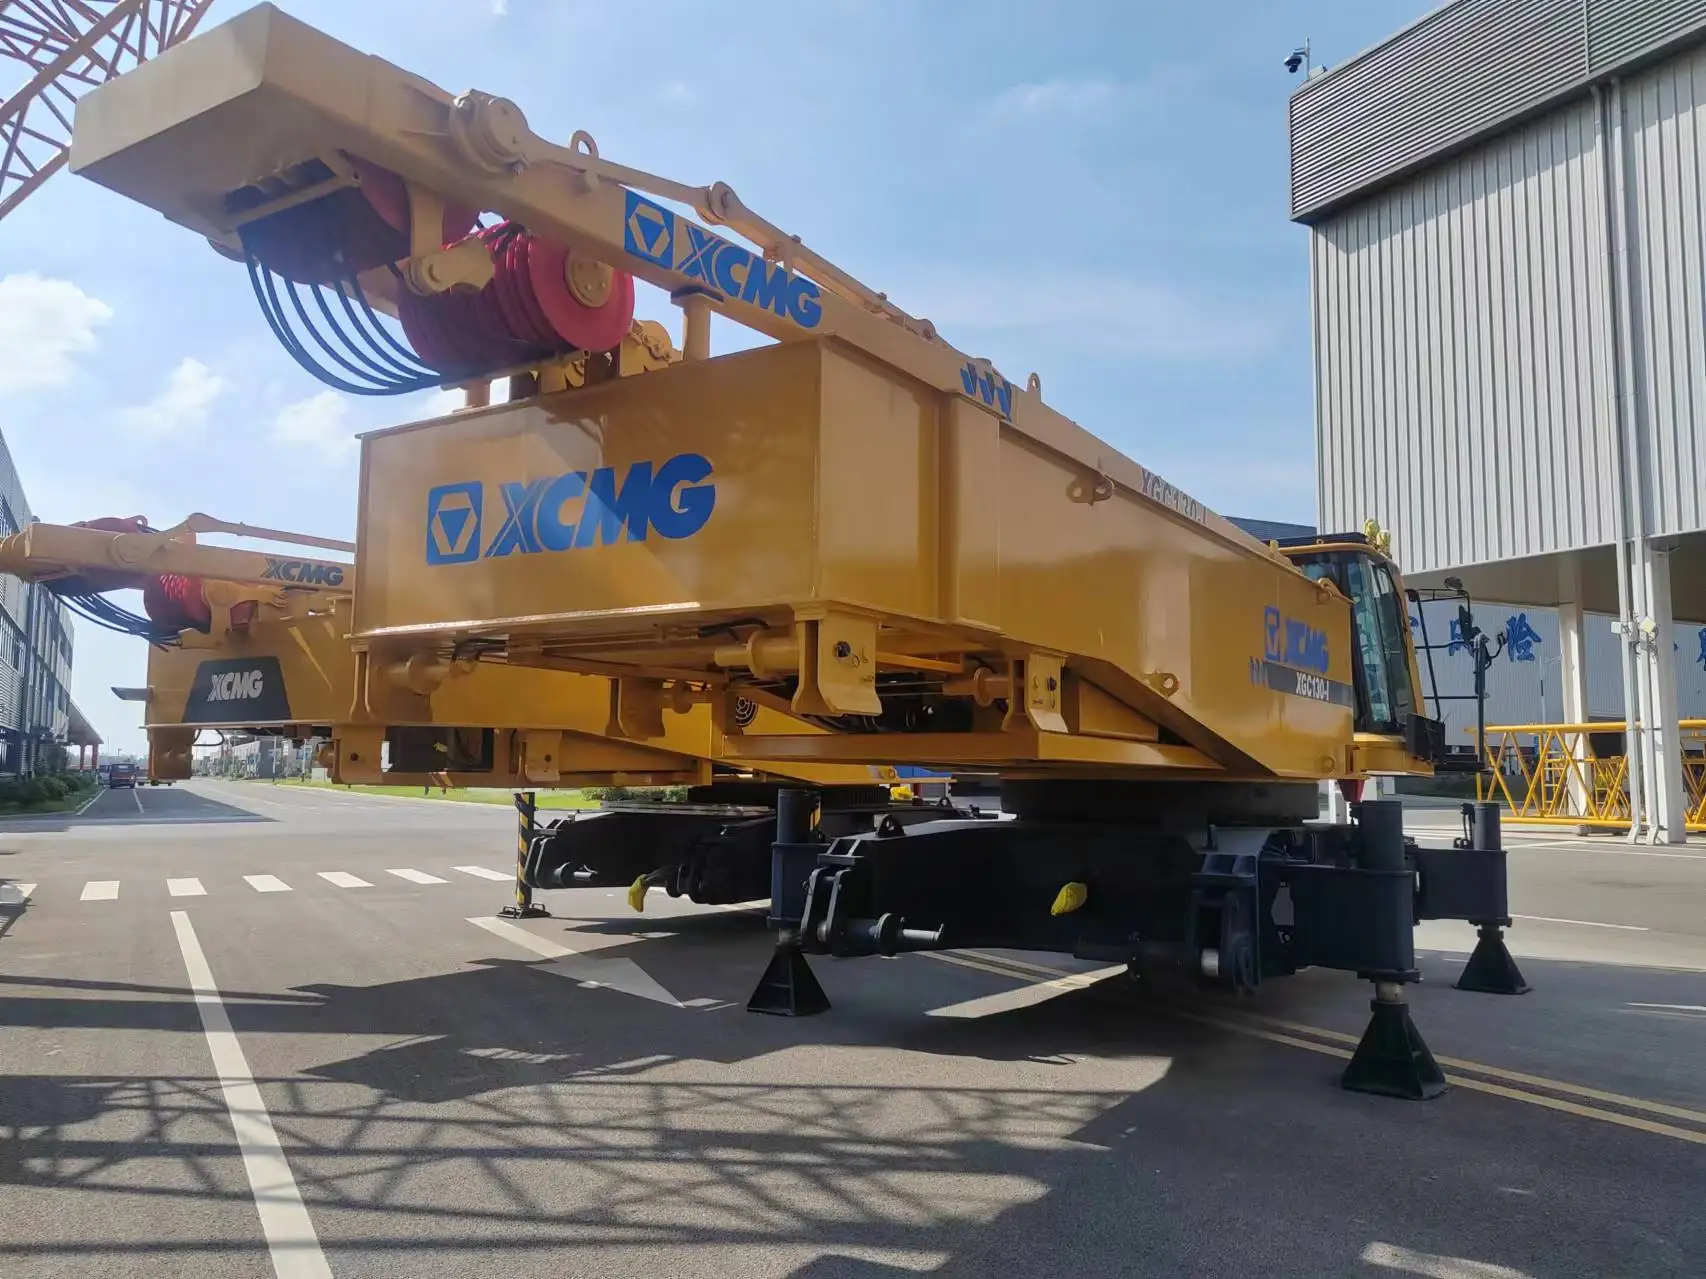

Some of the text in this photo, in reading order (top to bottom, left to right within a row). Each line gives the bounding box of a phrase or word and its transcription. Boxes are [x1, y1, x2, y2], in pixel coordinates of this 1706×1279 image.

[676, 224, 822, 328] XCMG
[484, 453, 716, 558] XCMG
[260, 557, 344, 586] XCMG
[207, 669, 263, 702] XCMG
[1296, 671, 1330, 701] XGC130-I
